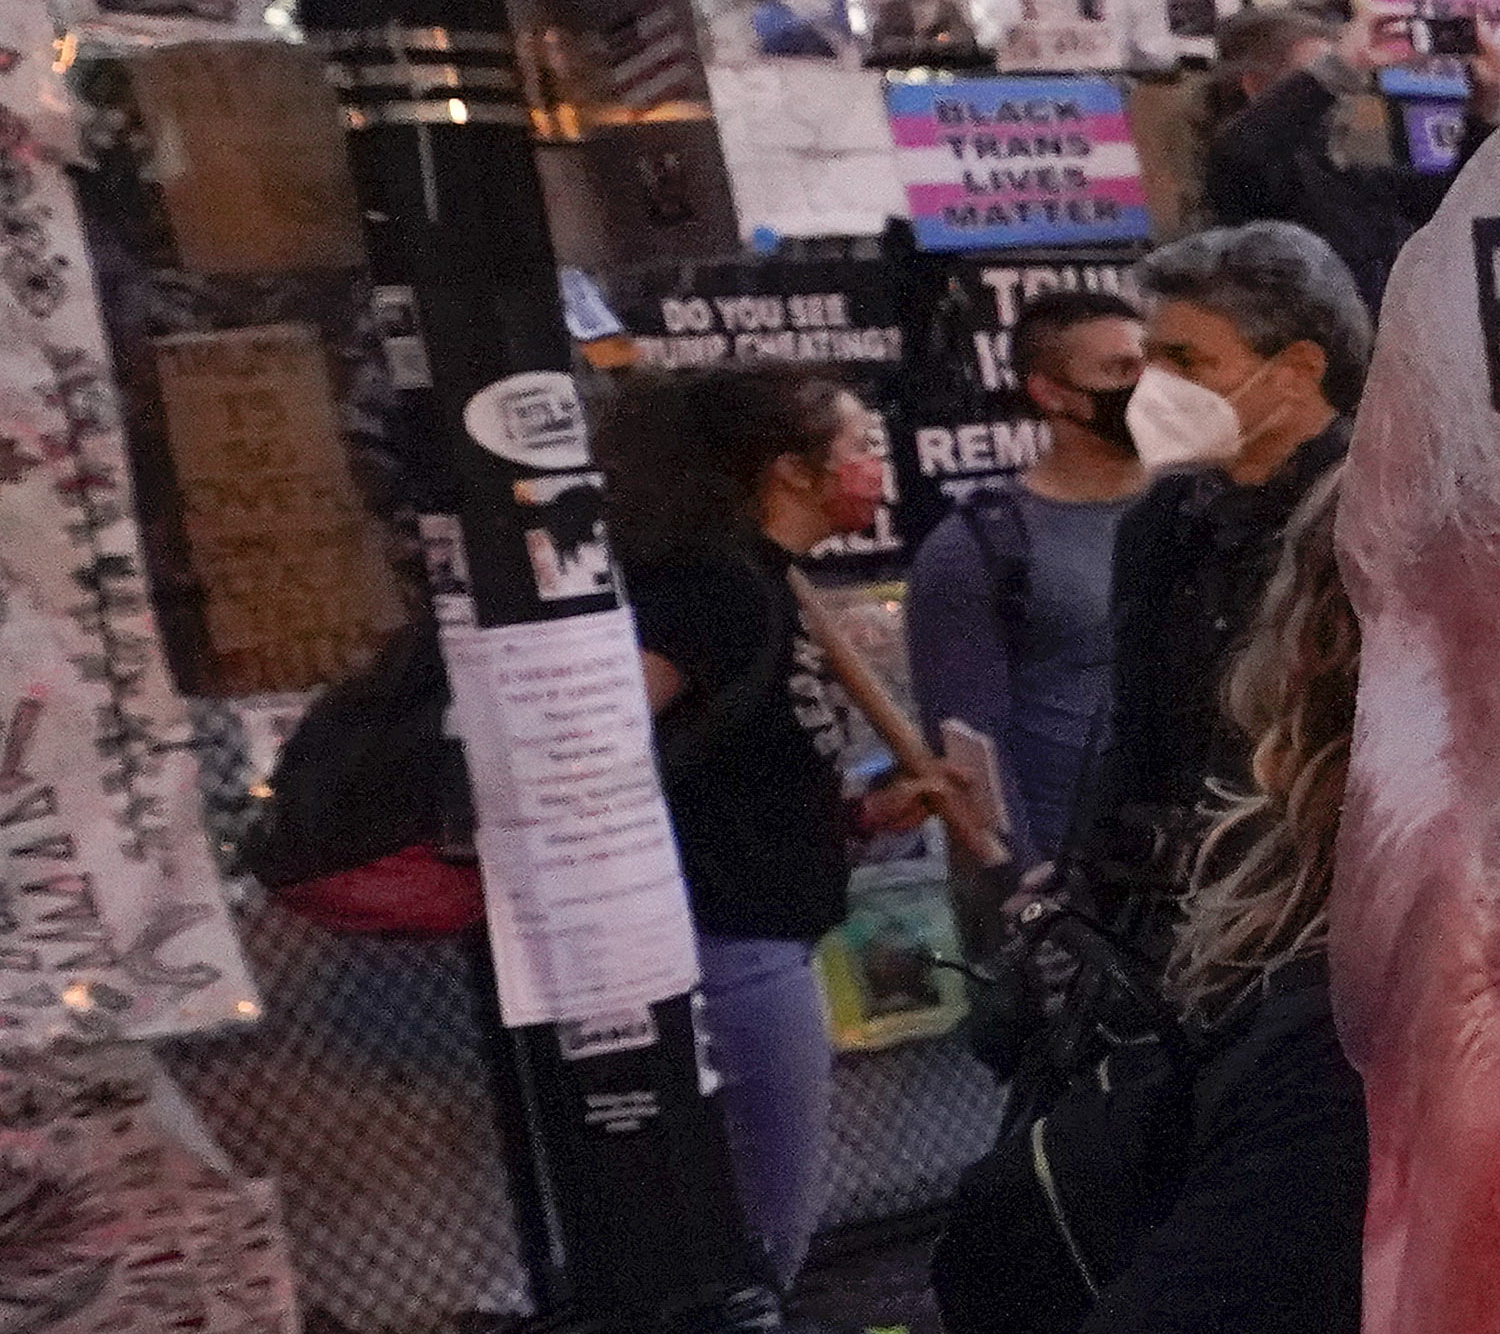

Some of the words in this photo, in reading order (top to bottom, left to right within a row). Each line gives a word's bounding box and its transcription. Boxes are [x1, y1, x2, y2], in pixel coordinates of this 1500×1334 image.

[936, 99, 1085, 128] BLACK
[945, 134, 1091, 160] TRANS
[963, 165, 1088, 195] LIVES
[944, 200, 1122, 229] MATTER
[661, 297, 713, 332] DO
[714, 296, 785, 330] YOU
[786, 293, 850, 327] SEE
